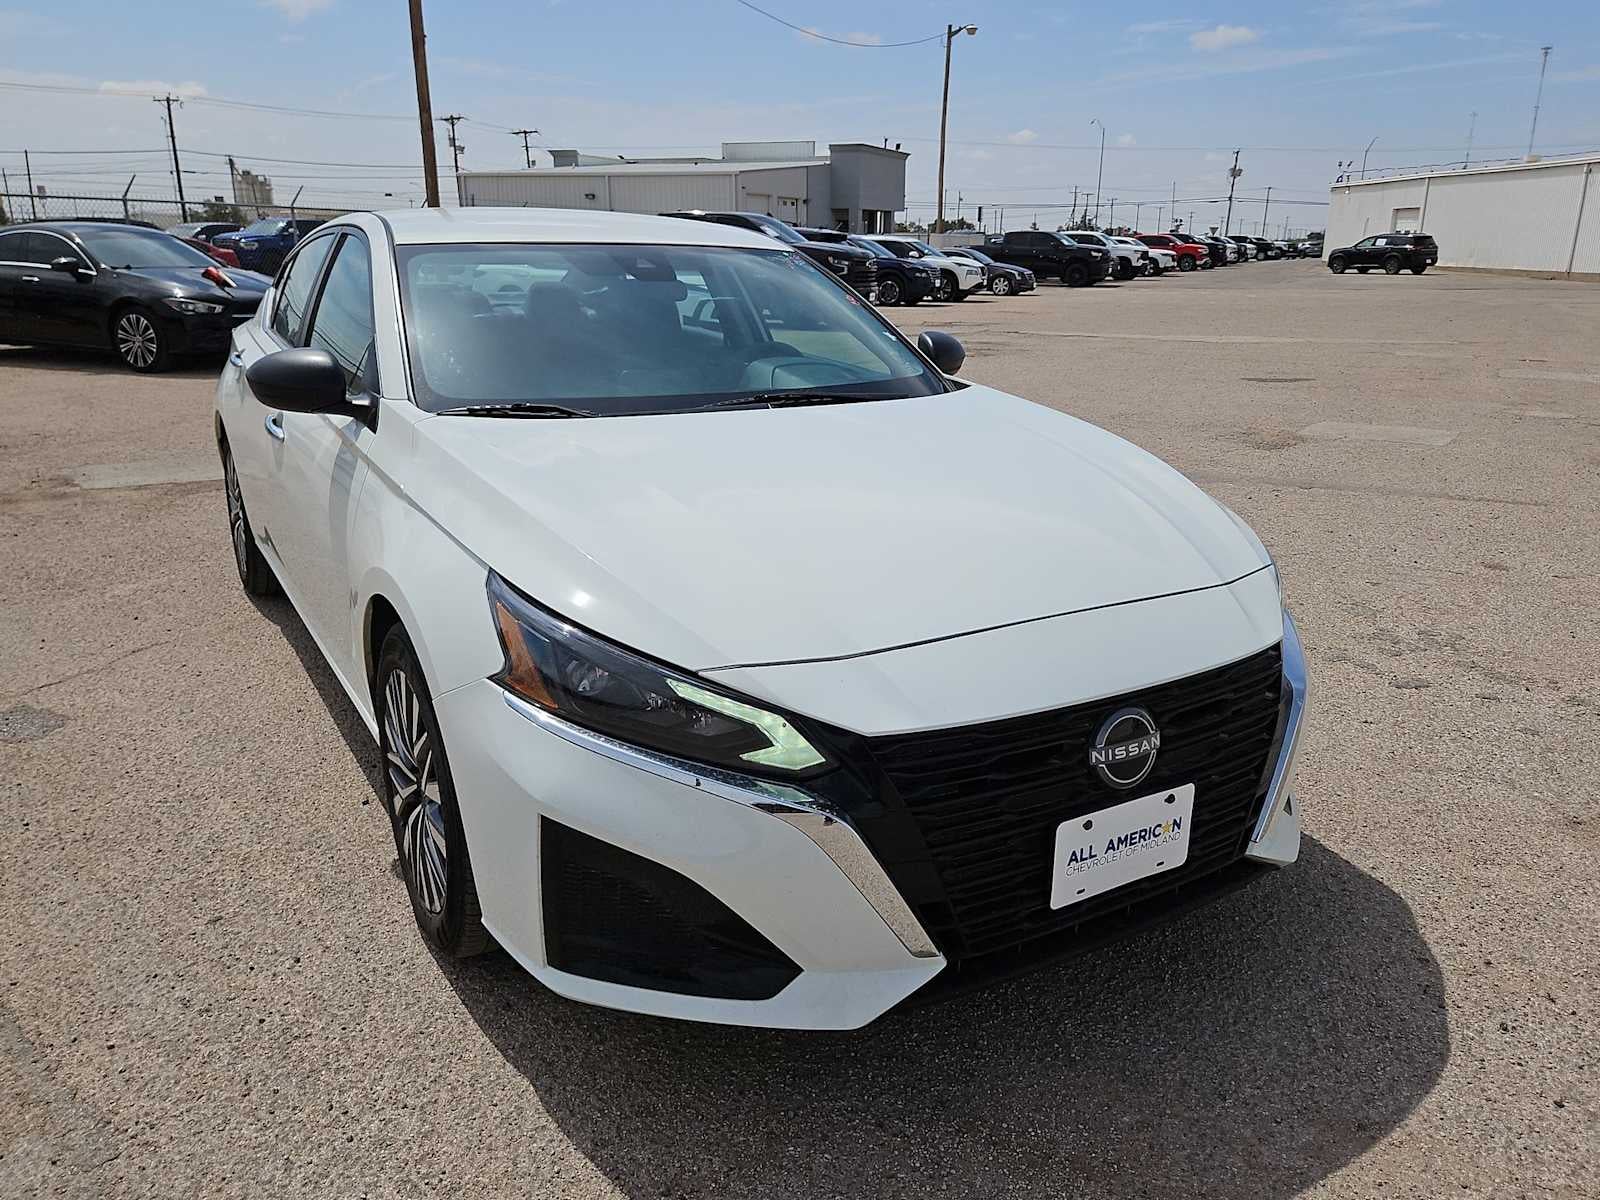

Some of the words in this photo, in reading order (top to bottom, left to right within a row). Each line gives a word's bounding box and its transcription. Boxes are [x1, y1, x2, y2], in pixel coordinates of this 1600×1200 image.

[1091, 730, 1160, 763] NISSAN
[1065, 850, 1123, 877] CHEVROLET
[1125, 845, 1139, 857] OF
[1140, 831, 1181, 851] MIDLAND
[1067, 844, 1097, 866] ALL
